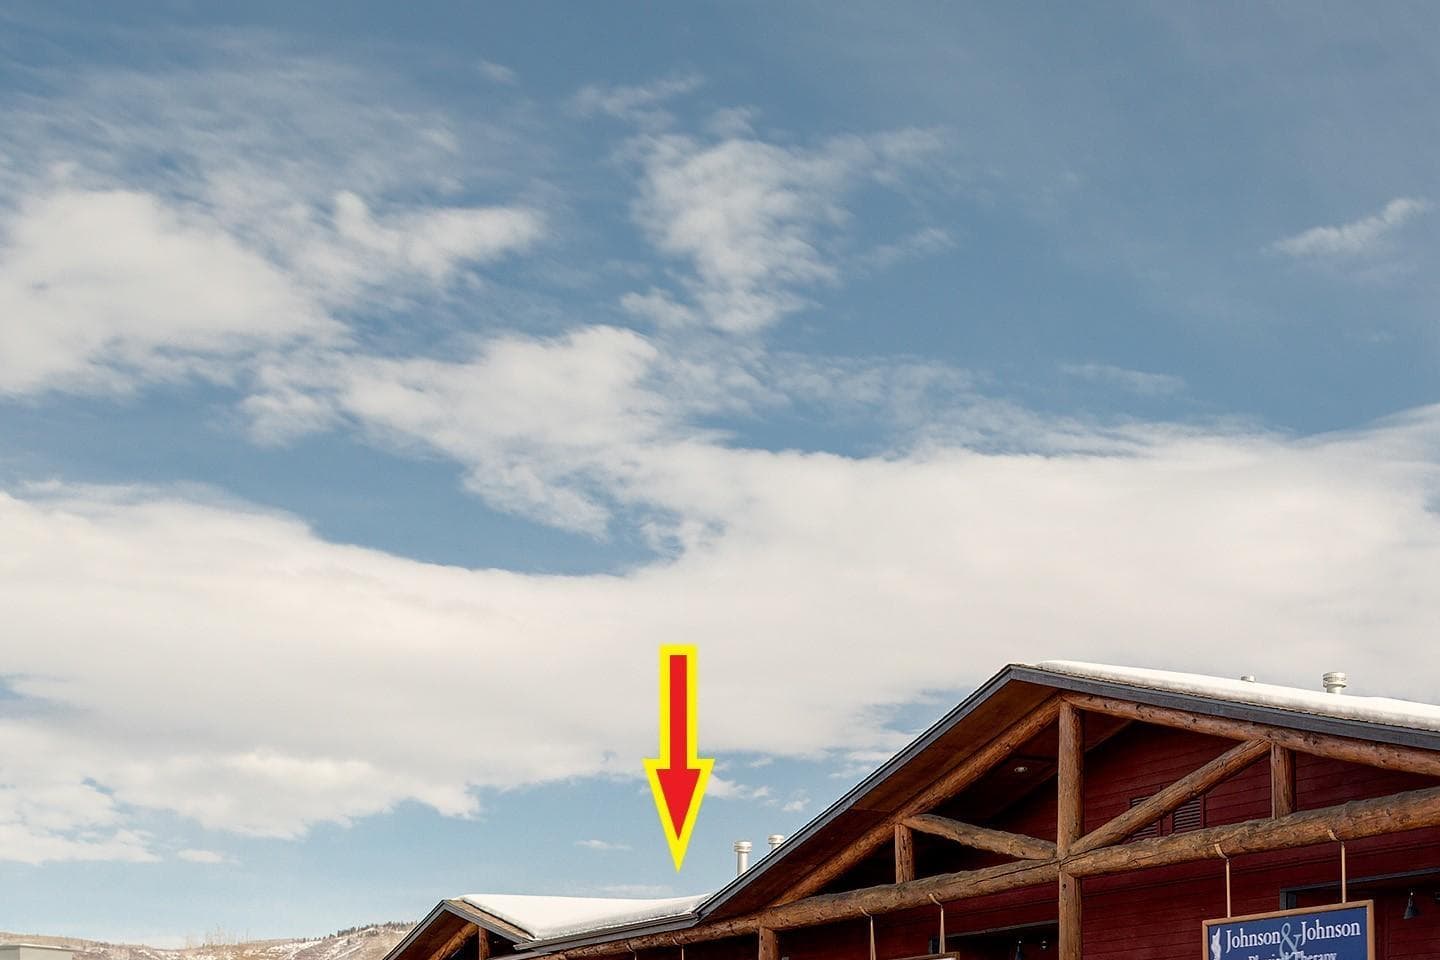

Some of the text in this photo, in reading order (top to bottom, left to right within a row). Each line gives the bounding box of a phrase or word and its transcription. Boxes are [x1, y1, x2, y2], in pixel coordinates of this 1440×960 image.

[1226, 919, 1361, 959] Johnson & Johnson
